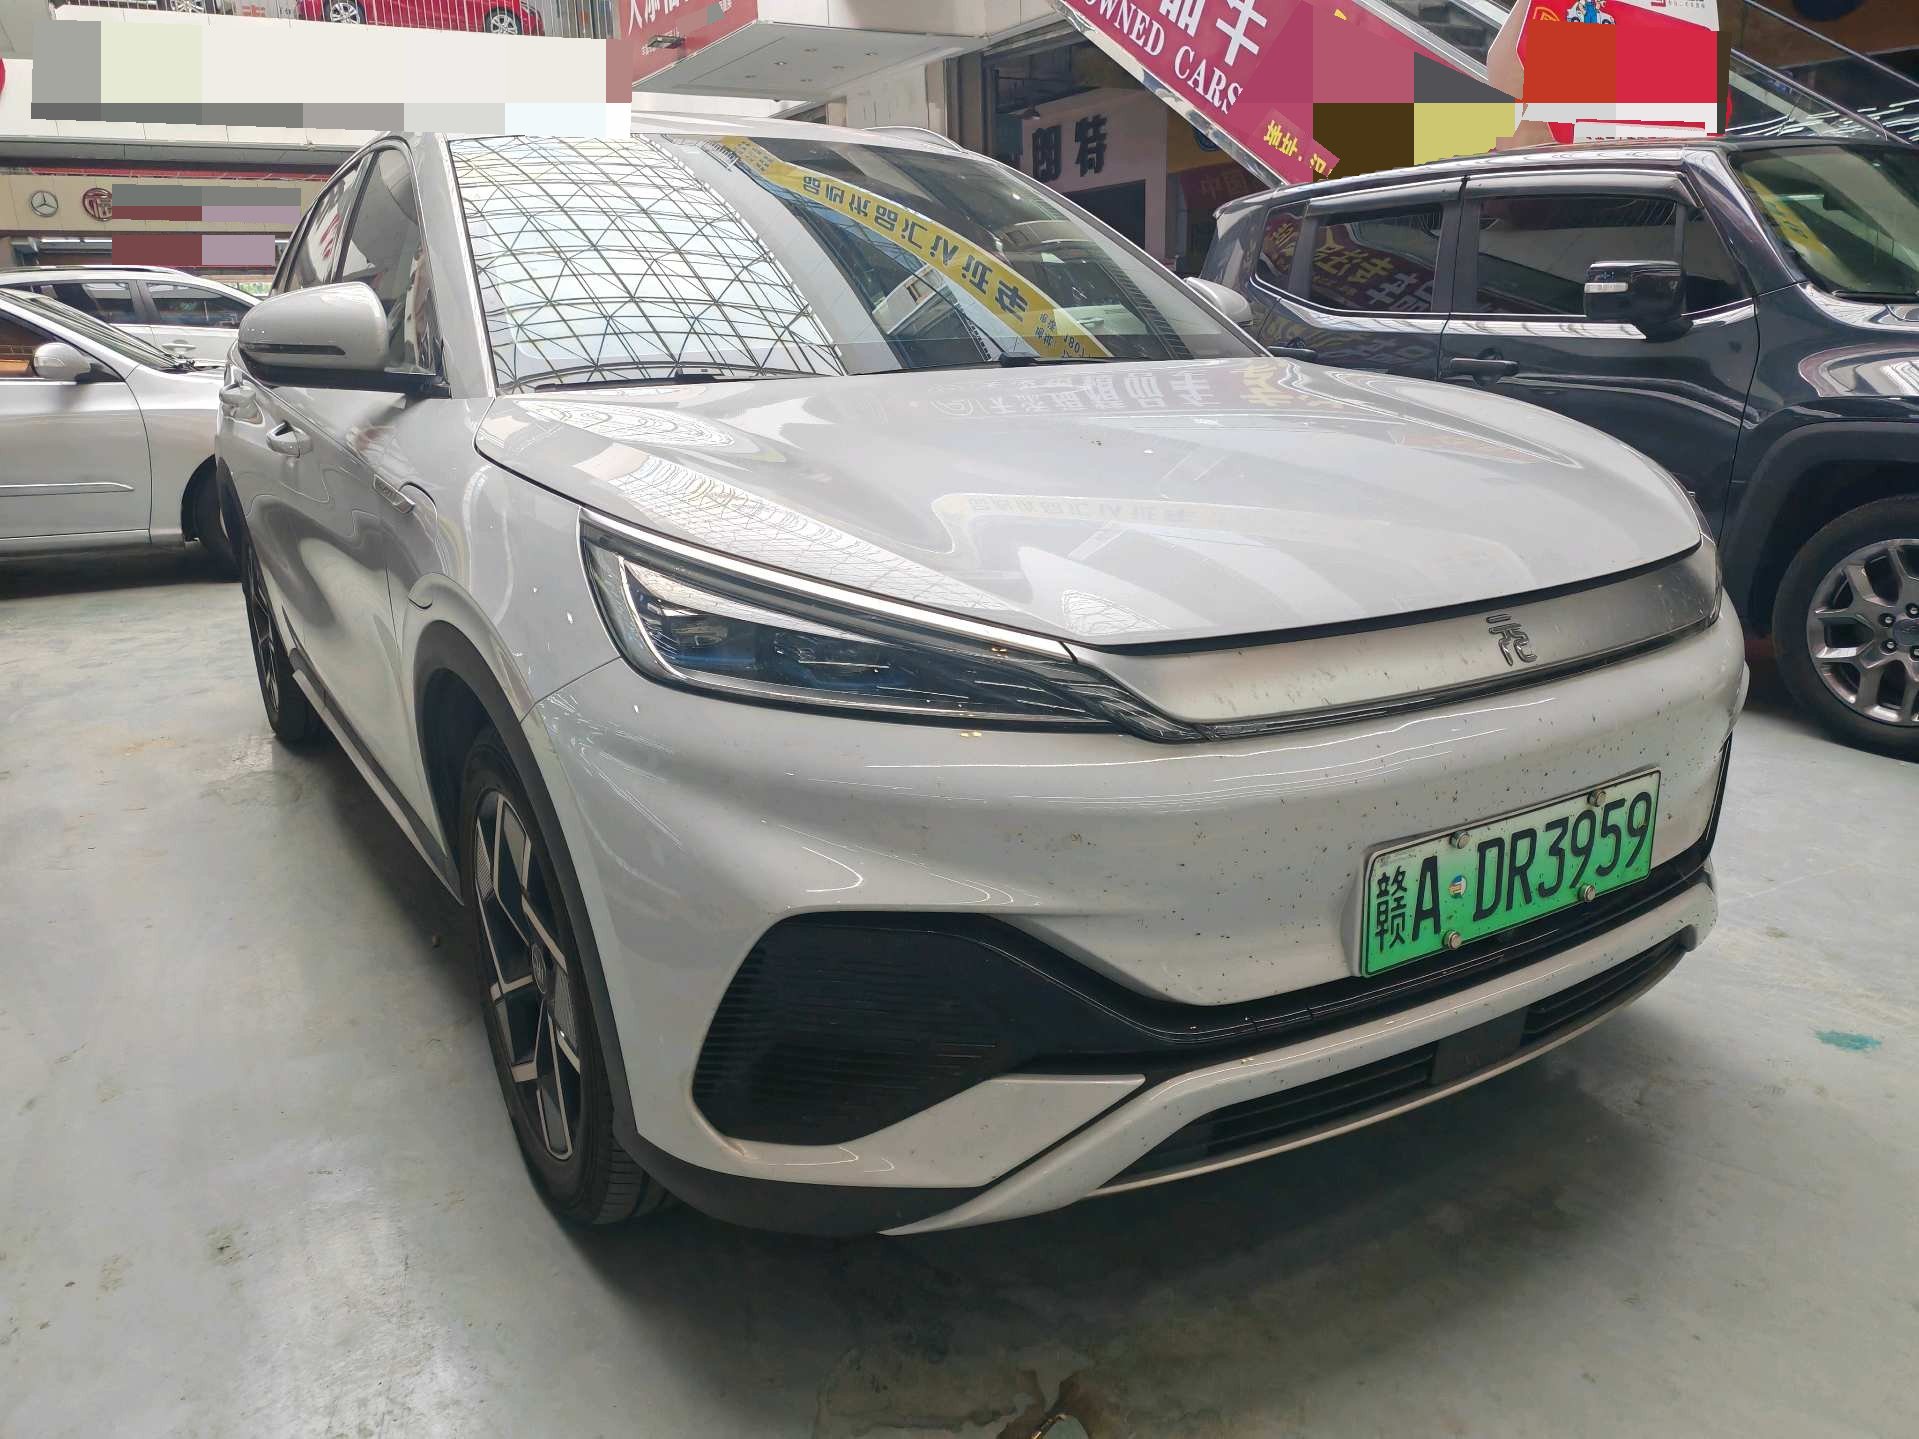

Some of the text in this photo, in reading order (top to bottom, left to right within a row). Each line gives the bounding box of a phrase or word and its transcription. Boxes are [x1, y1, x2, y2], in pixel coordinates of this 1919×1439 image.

[1083, 0, 1244, 115] WNED CARS
[1485, 613, 1538, 668] 元
